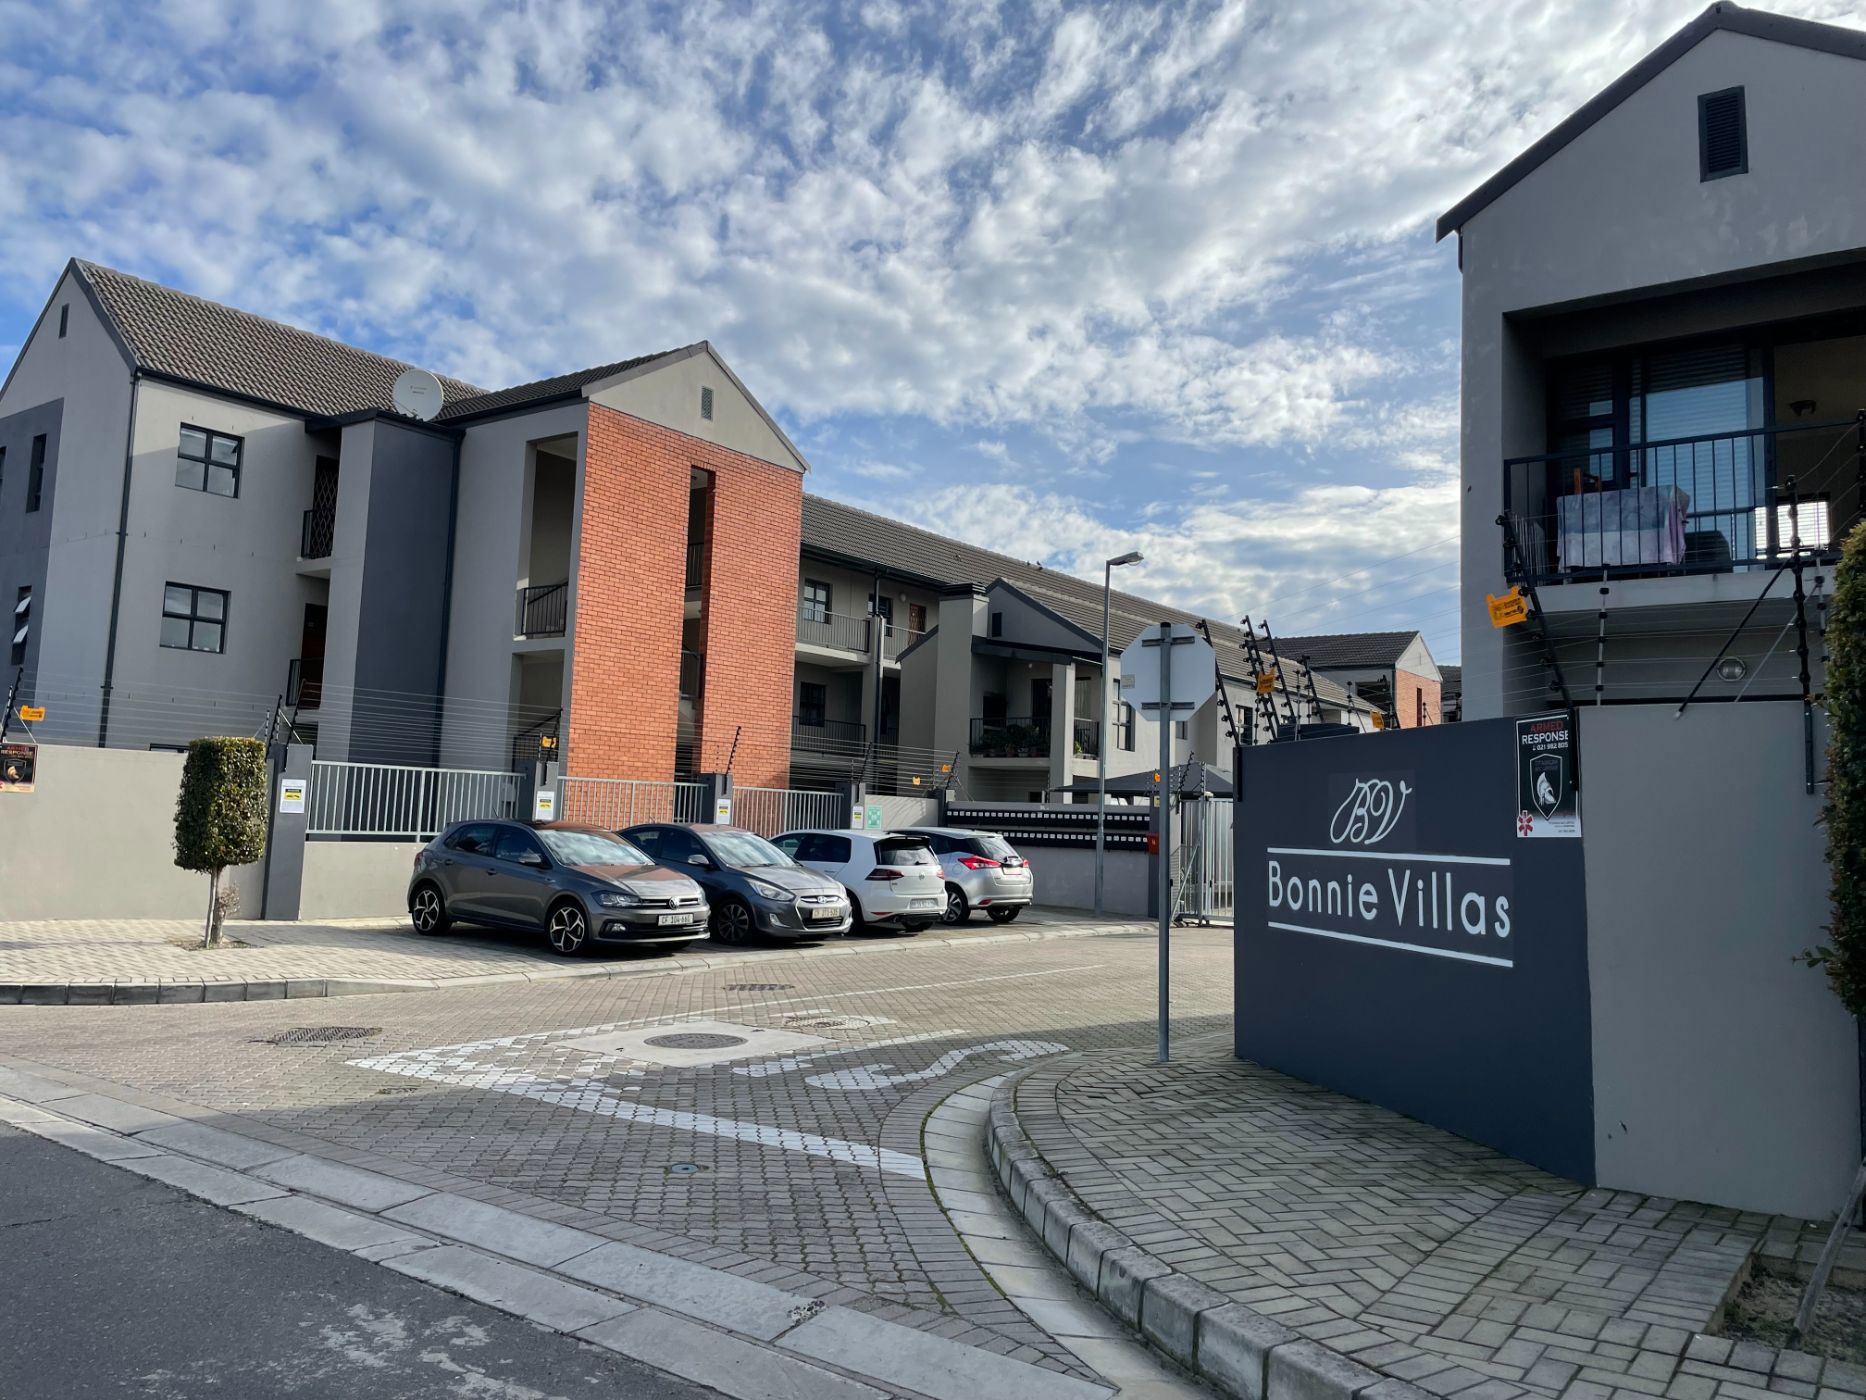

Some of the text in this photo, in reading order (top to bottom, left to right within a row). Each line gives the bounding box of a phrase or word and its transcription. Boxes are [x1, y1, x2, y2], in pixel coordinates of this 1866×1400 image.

[1531, 720, 1564, 733] ARMED
[1521, 730, 1569, 745] RESPONSE
[1268, 860, 1511, 938] Bonnie Villas
